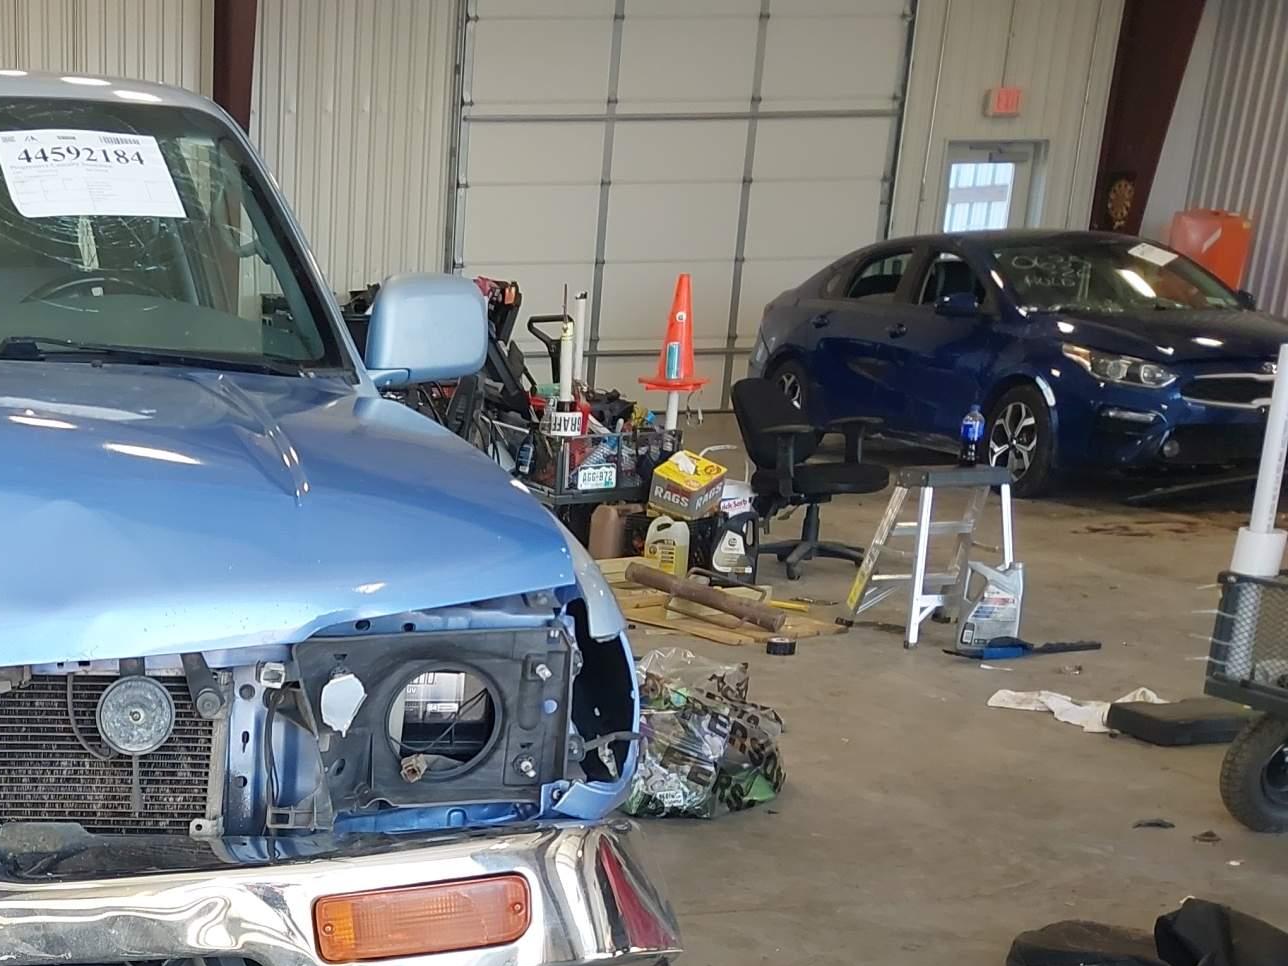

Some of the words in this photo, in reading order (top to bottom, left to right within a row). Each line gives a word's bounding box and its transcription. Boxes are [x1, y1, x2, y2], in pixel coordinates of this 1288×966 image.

[17, 145, 145, 166] 44592184
[654, 485, 689, 508] RAGS
[695, 481, 723, 511] RAGS
